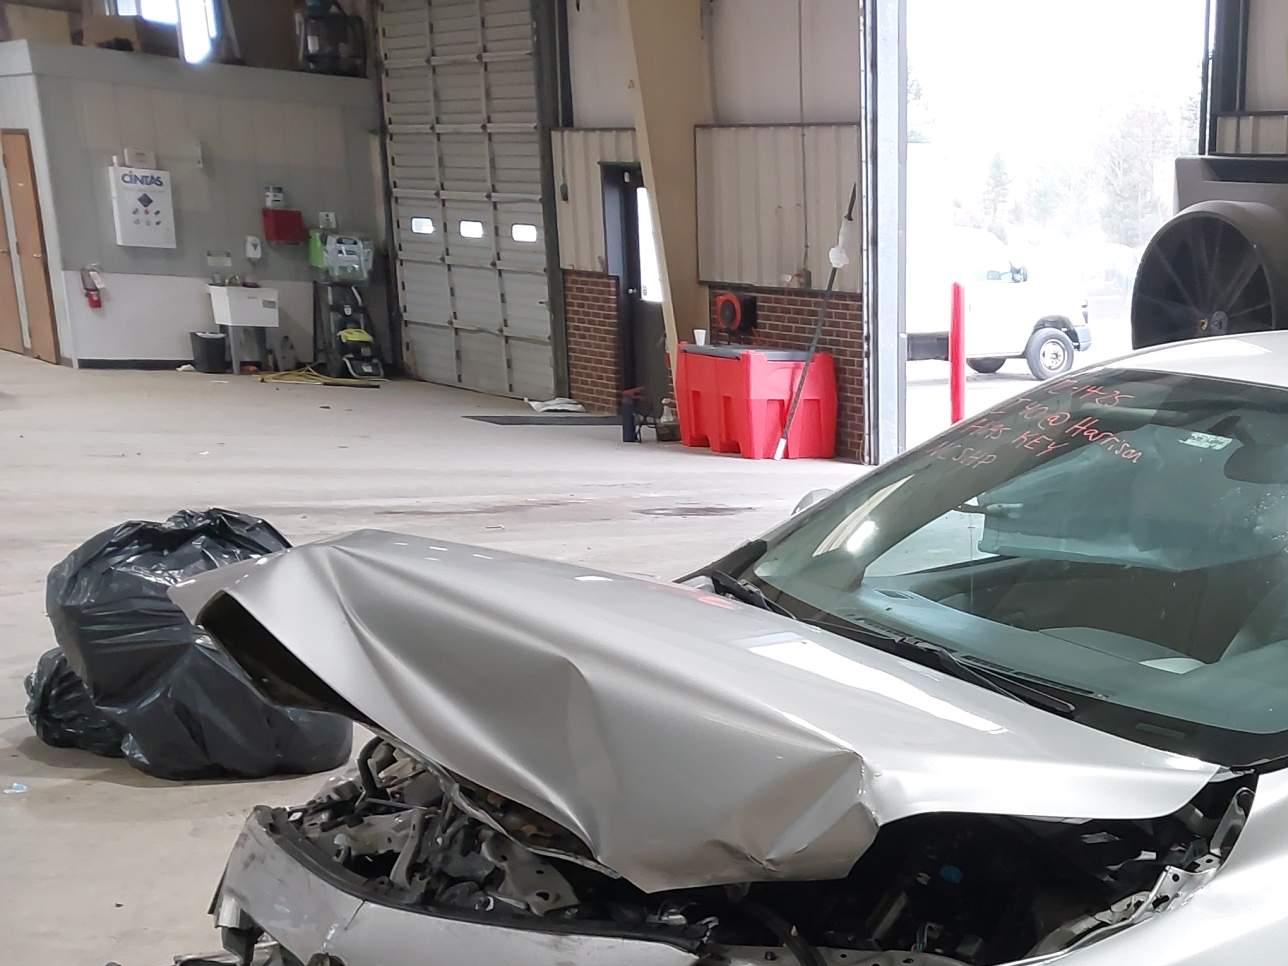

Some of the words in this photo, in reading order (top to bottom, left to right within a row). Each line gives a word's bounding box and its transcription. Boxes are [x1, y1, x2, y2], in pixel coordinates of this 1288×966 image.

[1012, 430, 1069, 457] KEY
[1038, 411, 1071, 430] @
[1065, 416, 1143, 464] Harrison
